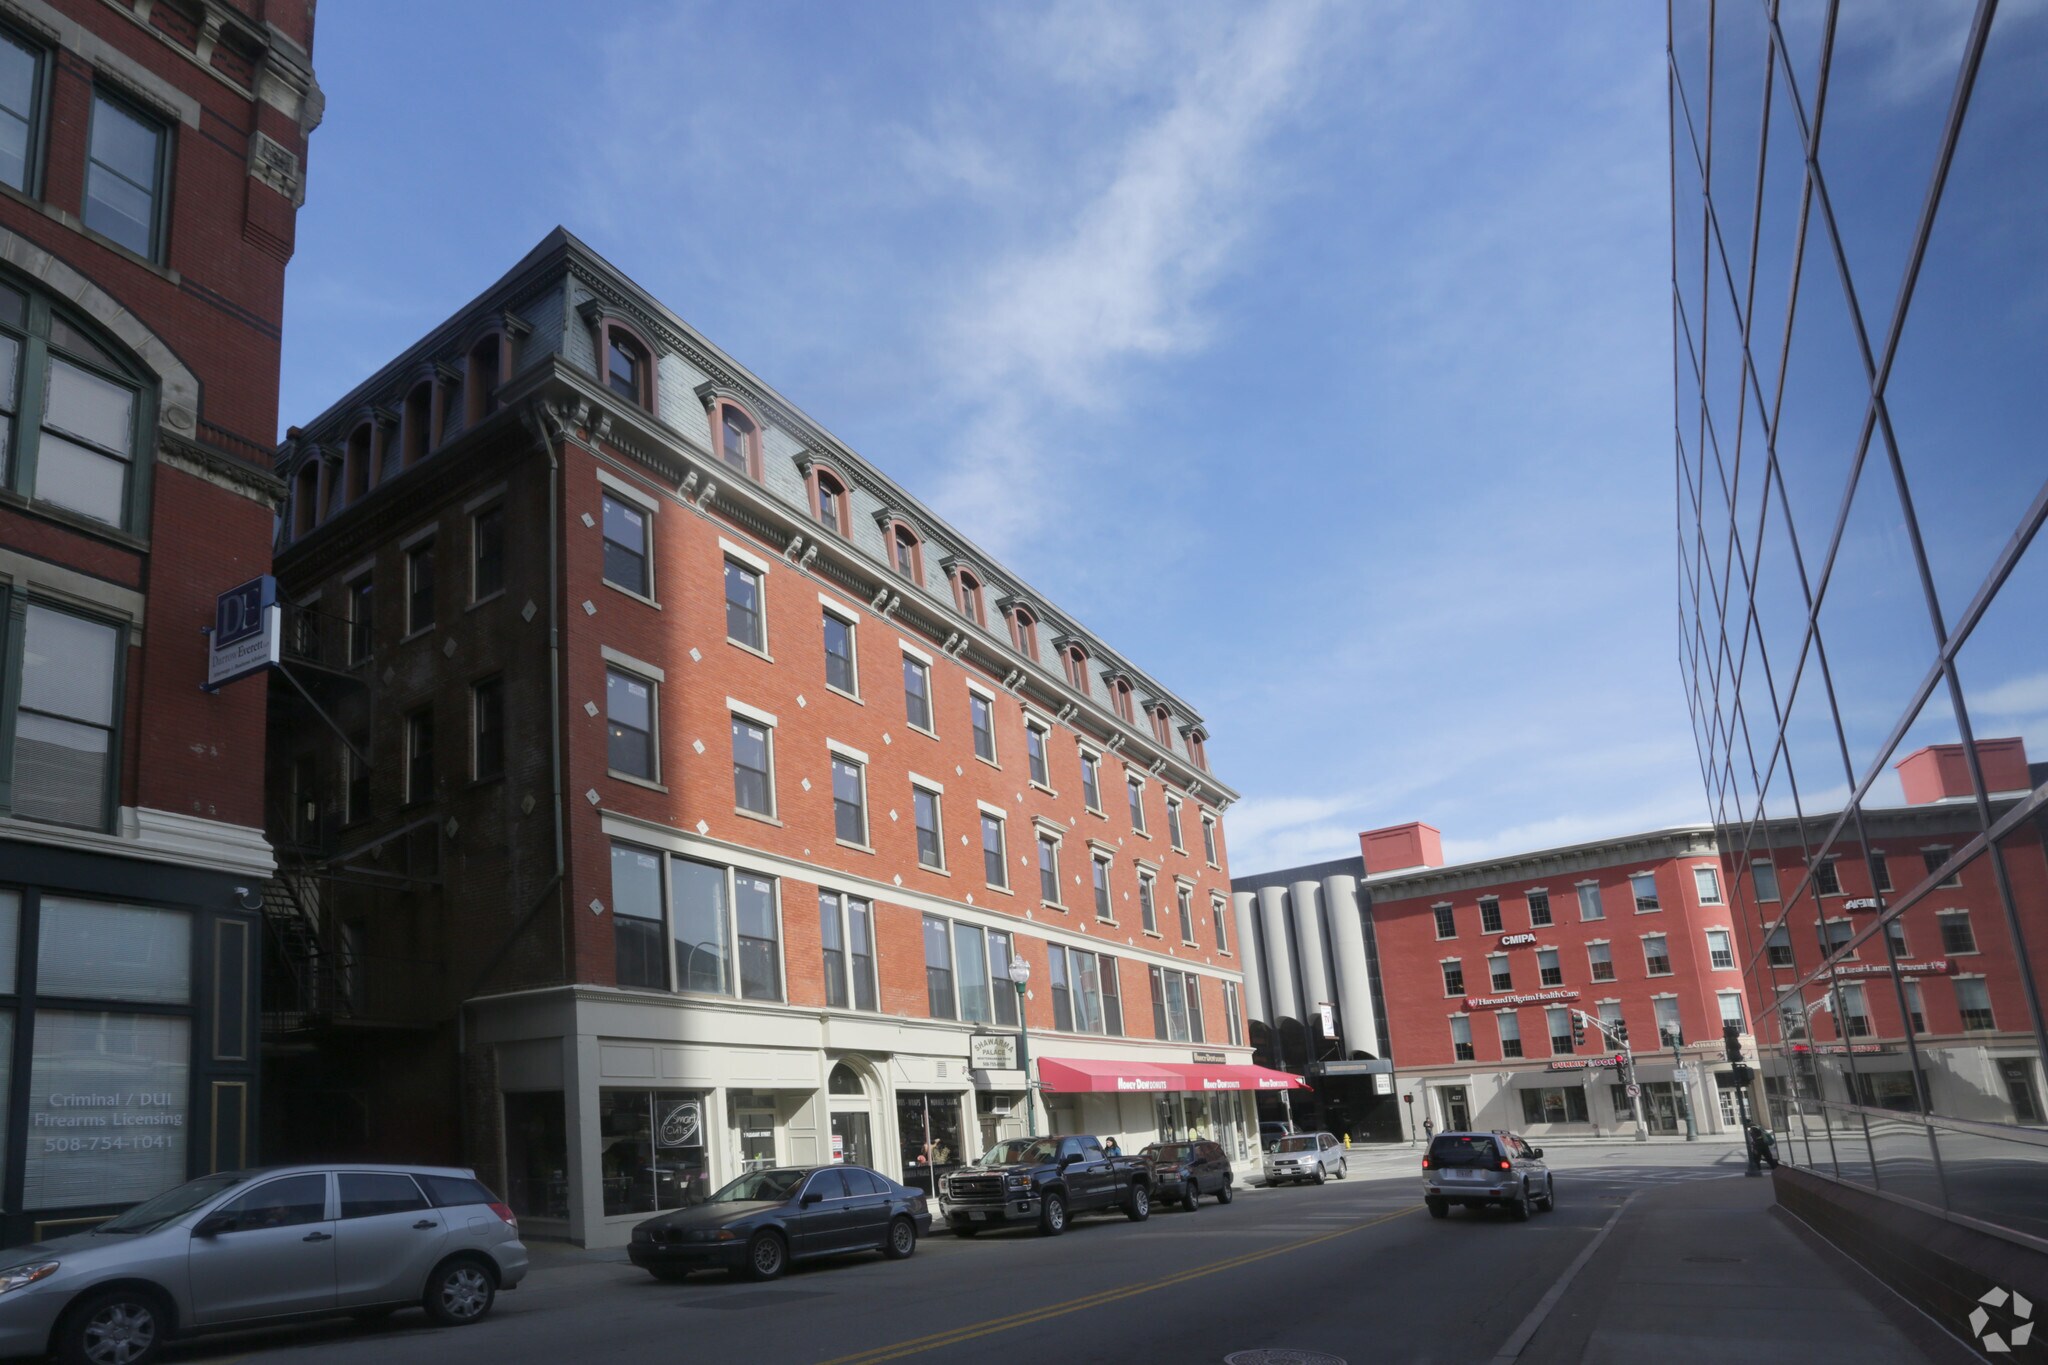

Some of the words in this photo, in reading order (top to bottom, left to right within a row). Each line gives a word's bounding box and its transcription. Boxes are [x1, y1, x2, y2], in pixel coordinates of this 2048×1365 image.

[238, 640, 263, 658] Everett
[1502, 933, 1537, 945] CMIPA
[1478, 995, 1508, 1006] Harvard
[1508, 994, 1536, 1004] Pilgrim
[1536, 991, 1560, 1001] Health
[974, 1038, 1014, 1053] SHAWARMA
[1552, 1060, 1587, 1069] DUNKIN'
[1118, 1077, 1136, 1089] HONEY
[1136, 1078, 1150, 1089] DEW
[1150, 1080, 1167, 1089] DONUTS
[50, 1093, 119, 1107] Criminal
[140, 1092, 172, 1106] DUI
[34, 1113, 106, 1127] Firearms
[113, 1112, 184, 1127] Licensing
[672, 1113, 697, 1125] Smart
[44, 1135, 173, 1152] 508-754-1041
